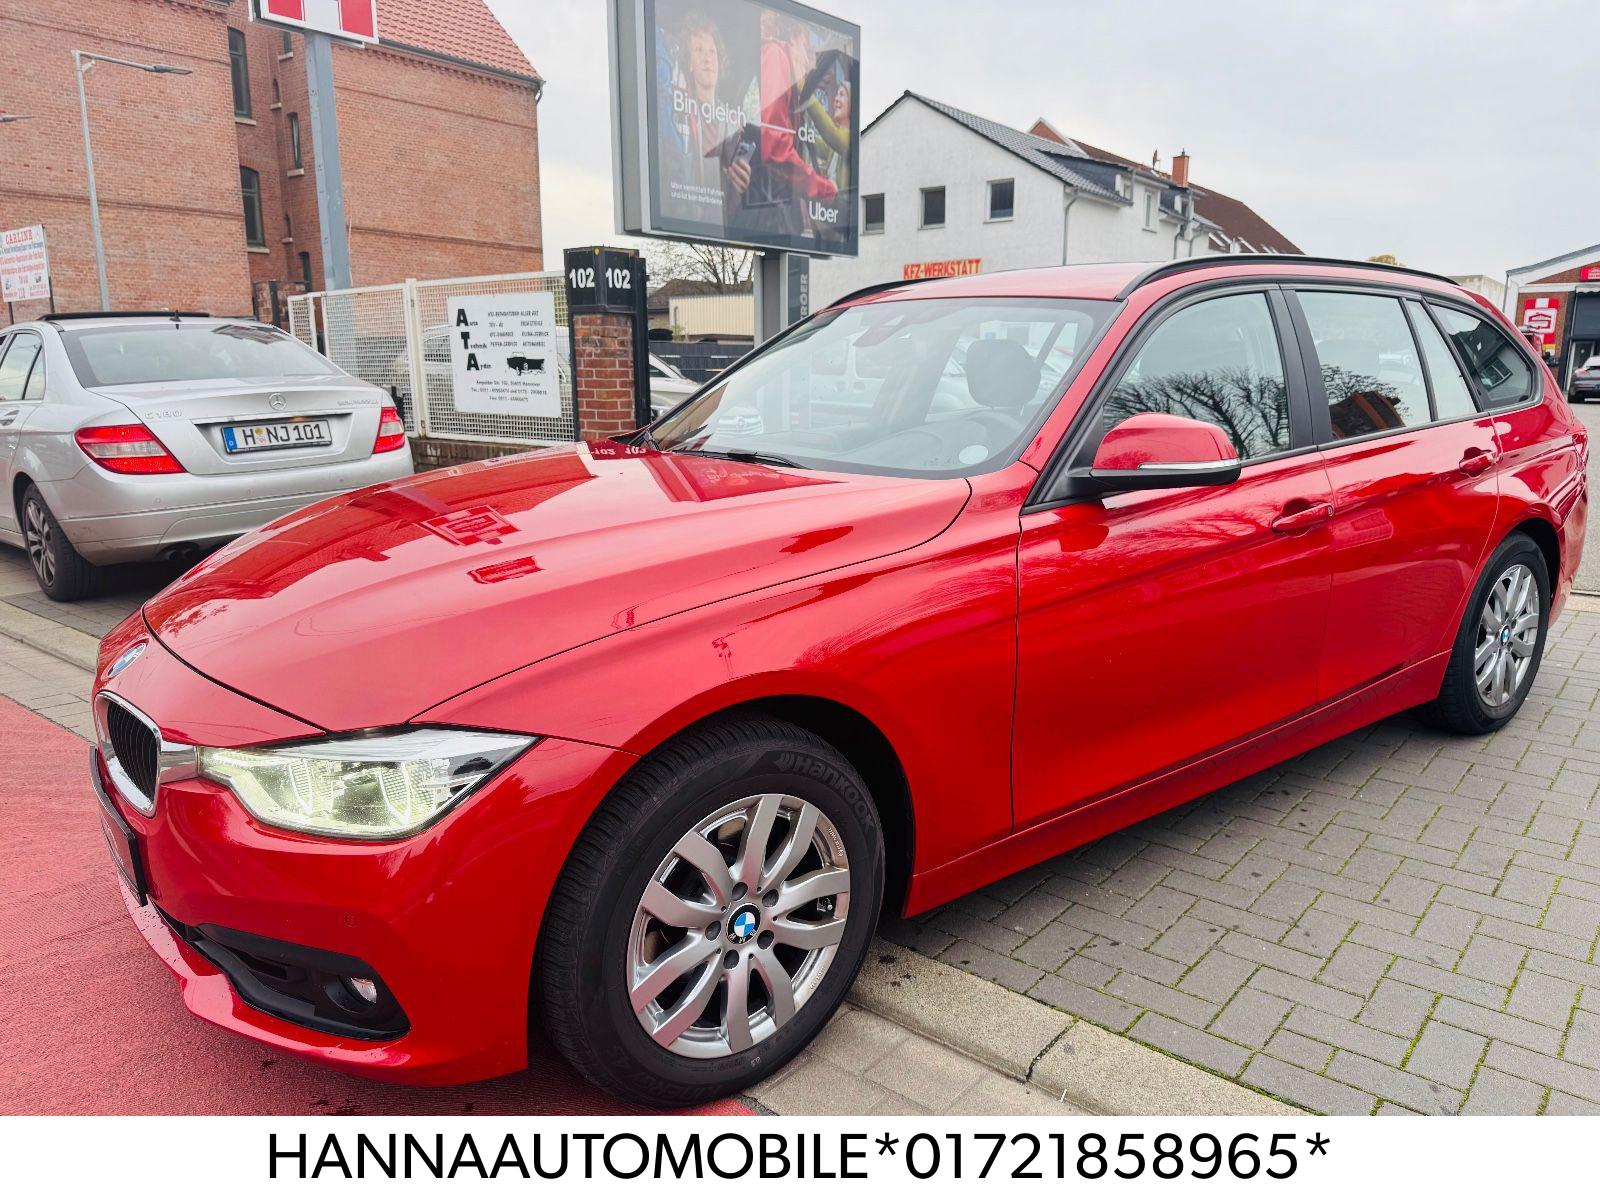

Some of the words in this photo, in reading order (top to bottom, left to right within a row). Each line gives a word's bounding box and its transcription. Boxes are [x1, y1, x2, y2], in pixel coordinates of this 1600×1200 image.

[673, 90, 697, 115] Bin
[701, 102, 747, 126] gleich
[797, 124, 816, 144] da
[808, 200, 839, 224] Uber
[6, 229, 33, 246] CARLINE
[569, 267, 595, 289] 102
[605, 267, 632, 290] 102
[903, 258, 981, 280] KFZ-WERKSTATT
[242, 428, 256, 446] H
[266, 425, 290, 444] NJ
[293, 423, 325, 441] 101
[793, 755, 877, 832] Hankook
